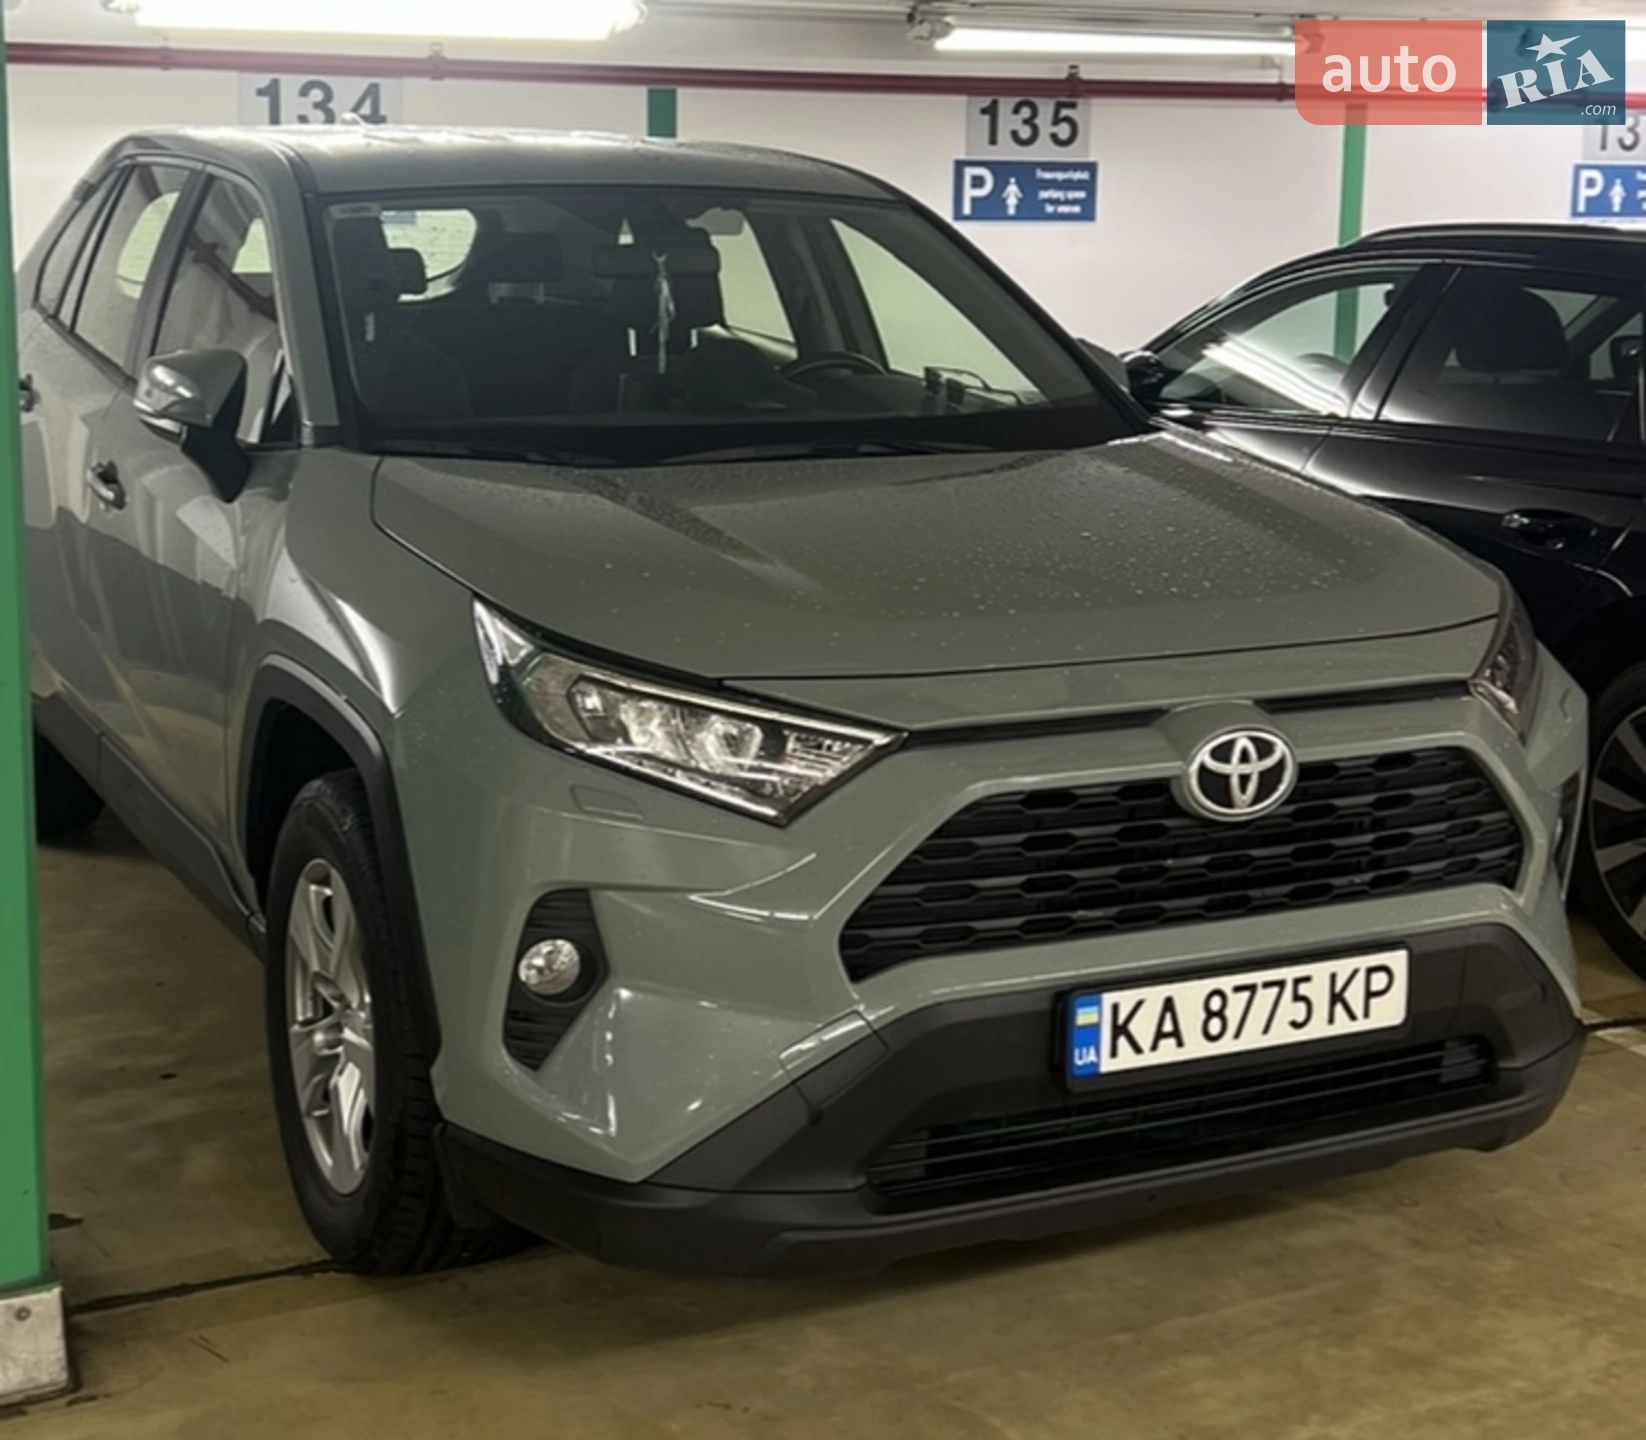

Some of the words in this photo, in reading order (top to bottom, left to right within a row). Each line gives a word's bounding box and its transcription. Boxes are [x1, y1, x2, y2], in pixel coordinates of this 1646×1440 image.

[255, 78, 387, 124] 134
[980, 99, 1078, 147] 135
[963, 166, 994, 215] P
[1577, 168, 1604, 213] P
[1109, 996, 1185, 1059] KA
[1202, 975, 1313, 1043] 8775
[1327, 964, 1395, 1026] KP
[1074, 1046, 1098, 1065] UA
